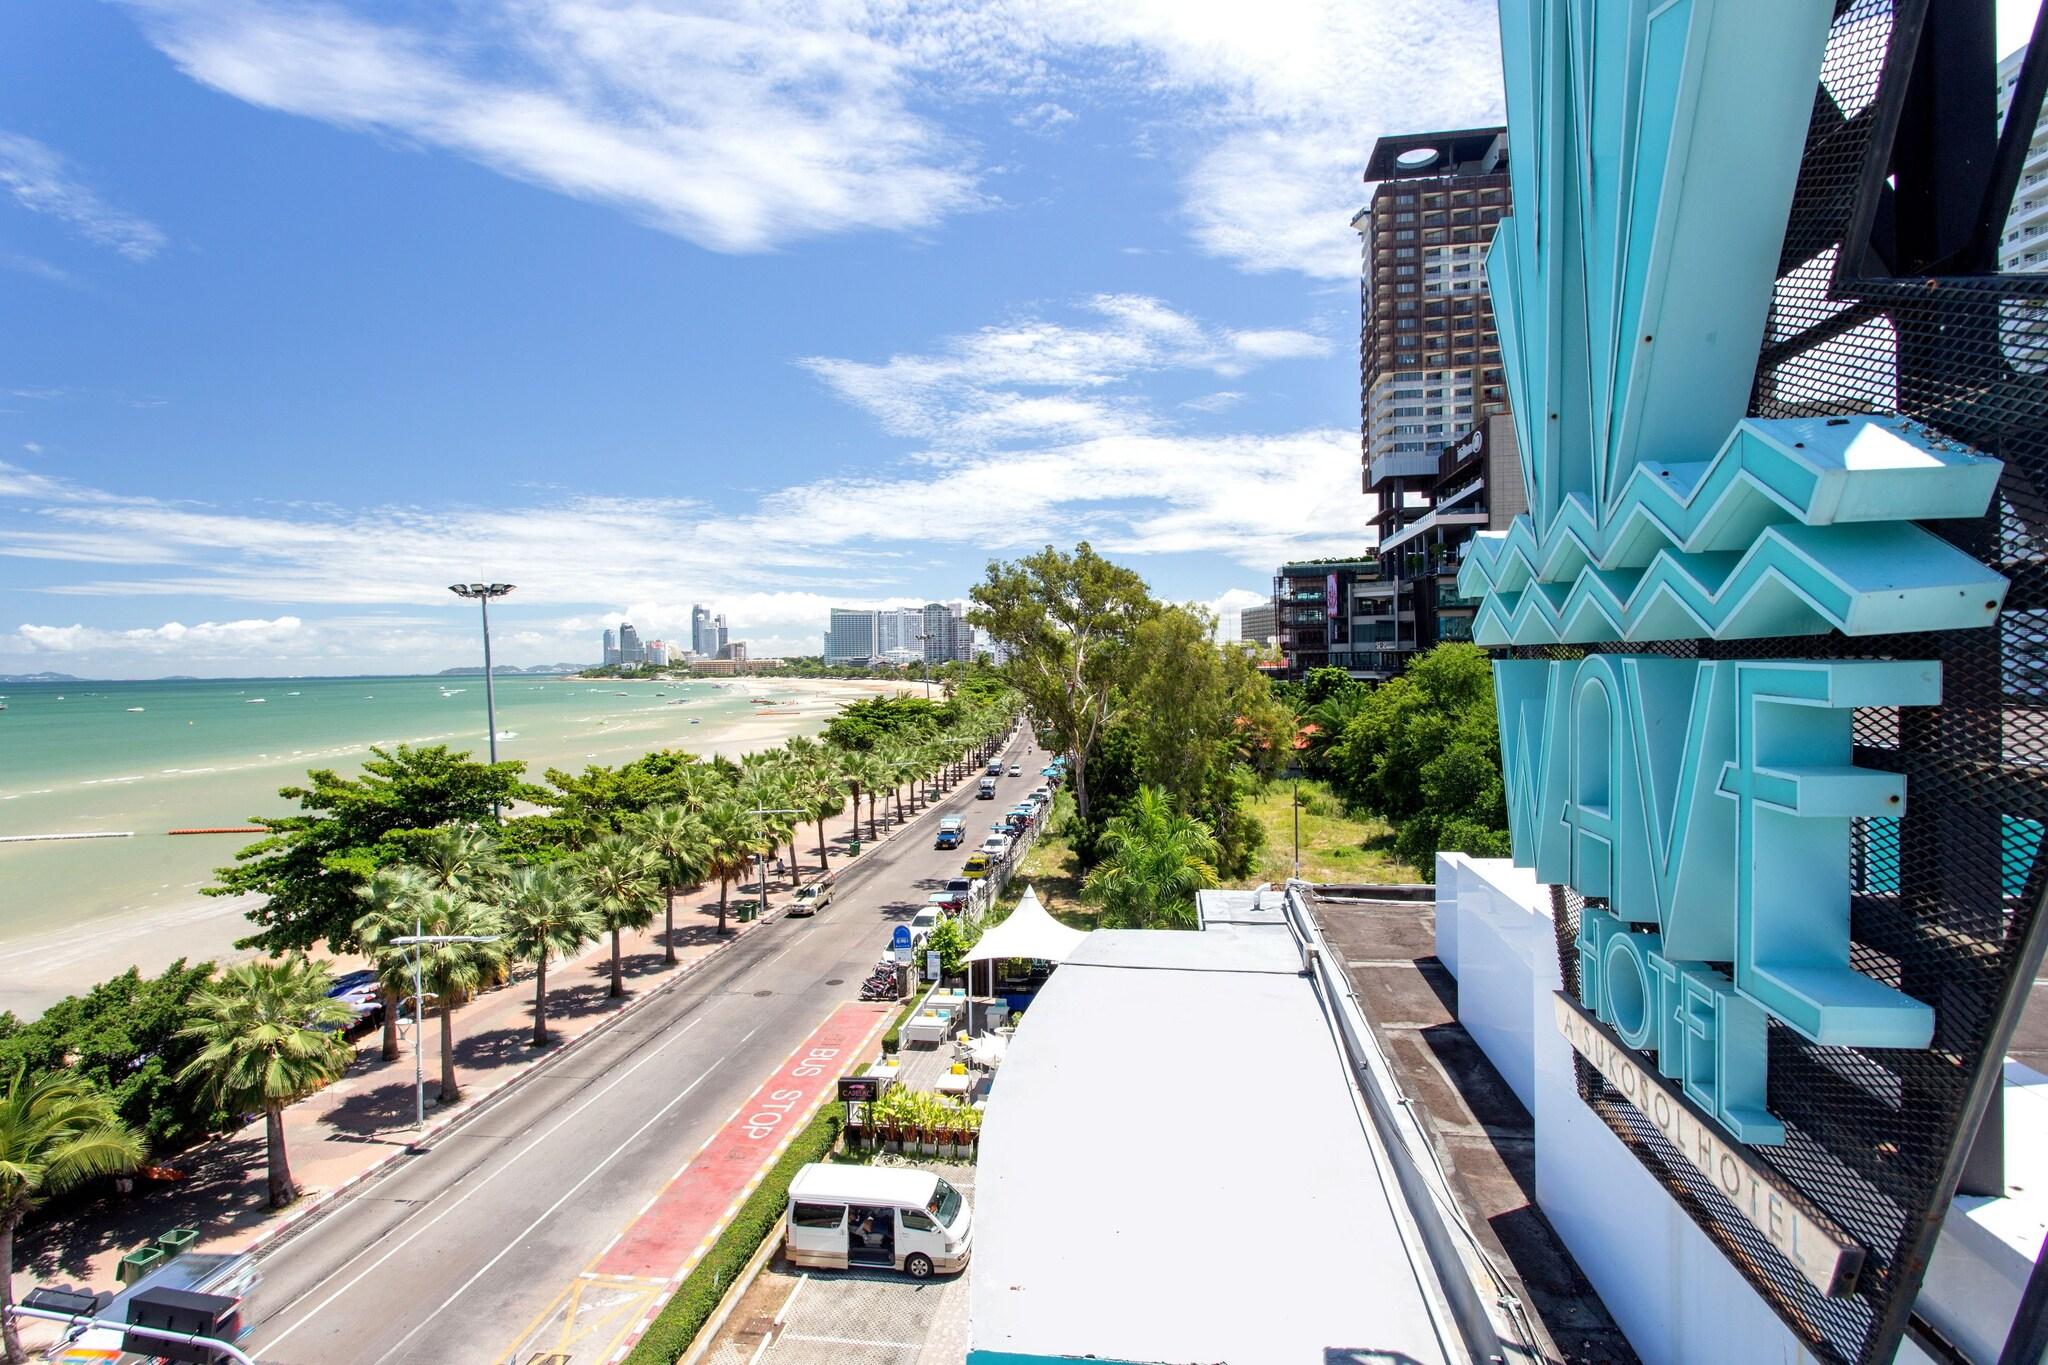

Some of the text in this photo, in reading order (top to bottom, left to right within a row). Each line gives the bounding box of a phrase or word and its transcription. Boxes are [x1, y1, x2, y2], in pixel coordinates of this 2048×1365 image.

[1492, 653, 1942, 1049] WAVE
[741, 1048, 840, 1140] BUS STOP
[1563, 1009, 1806, 1266] A SUKOSOL HOTEL
[1574, 907, 1785, 1146] HOTEL
